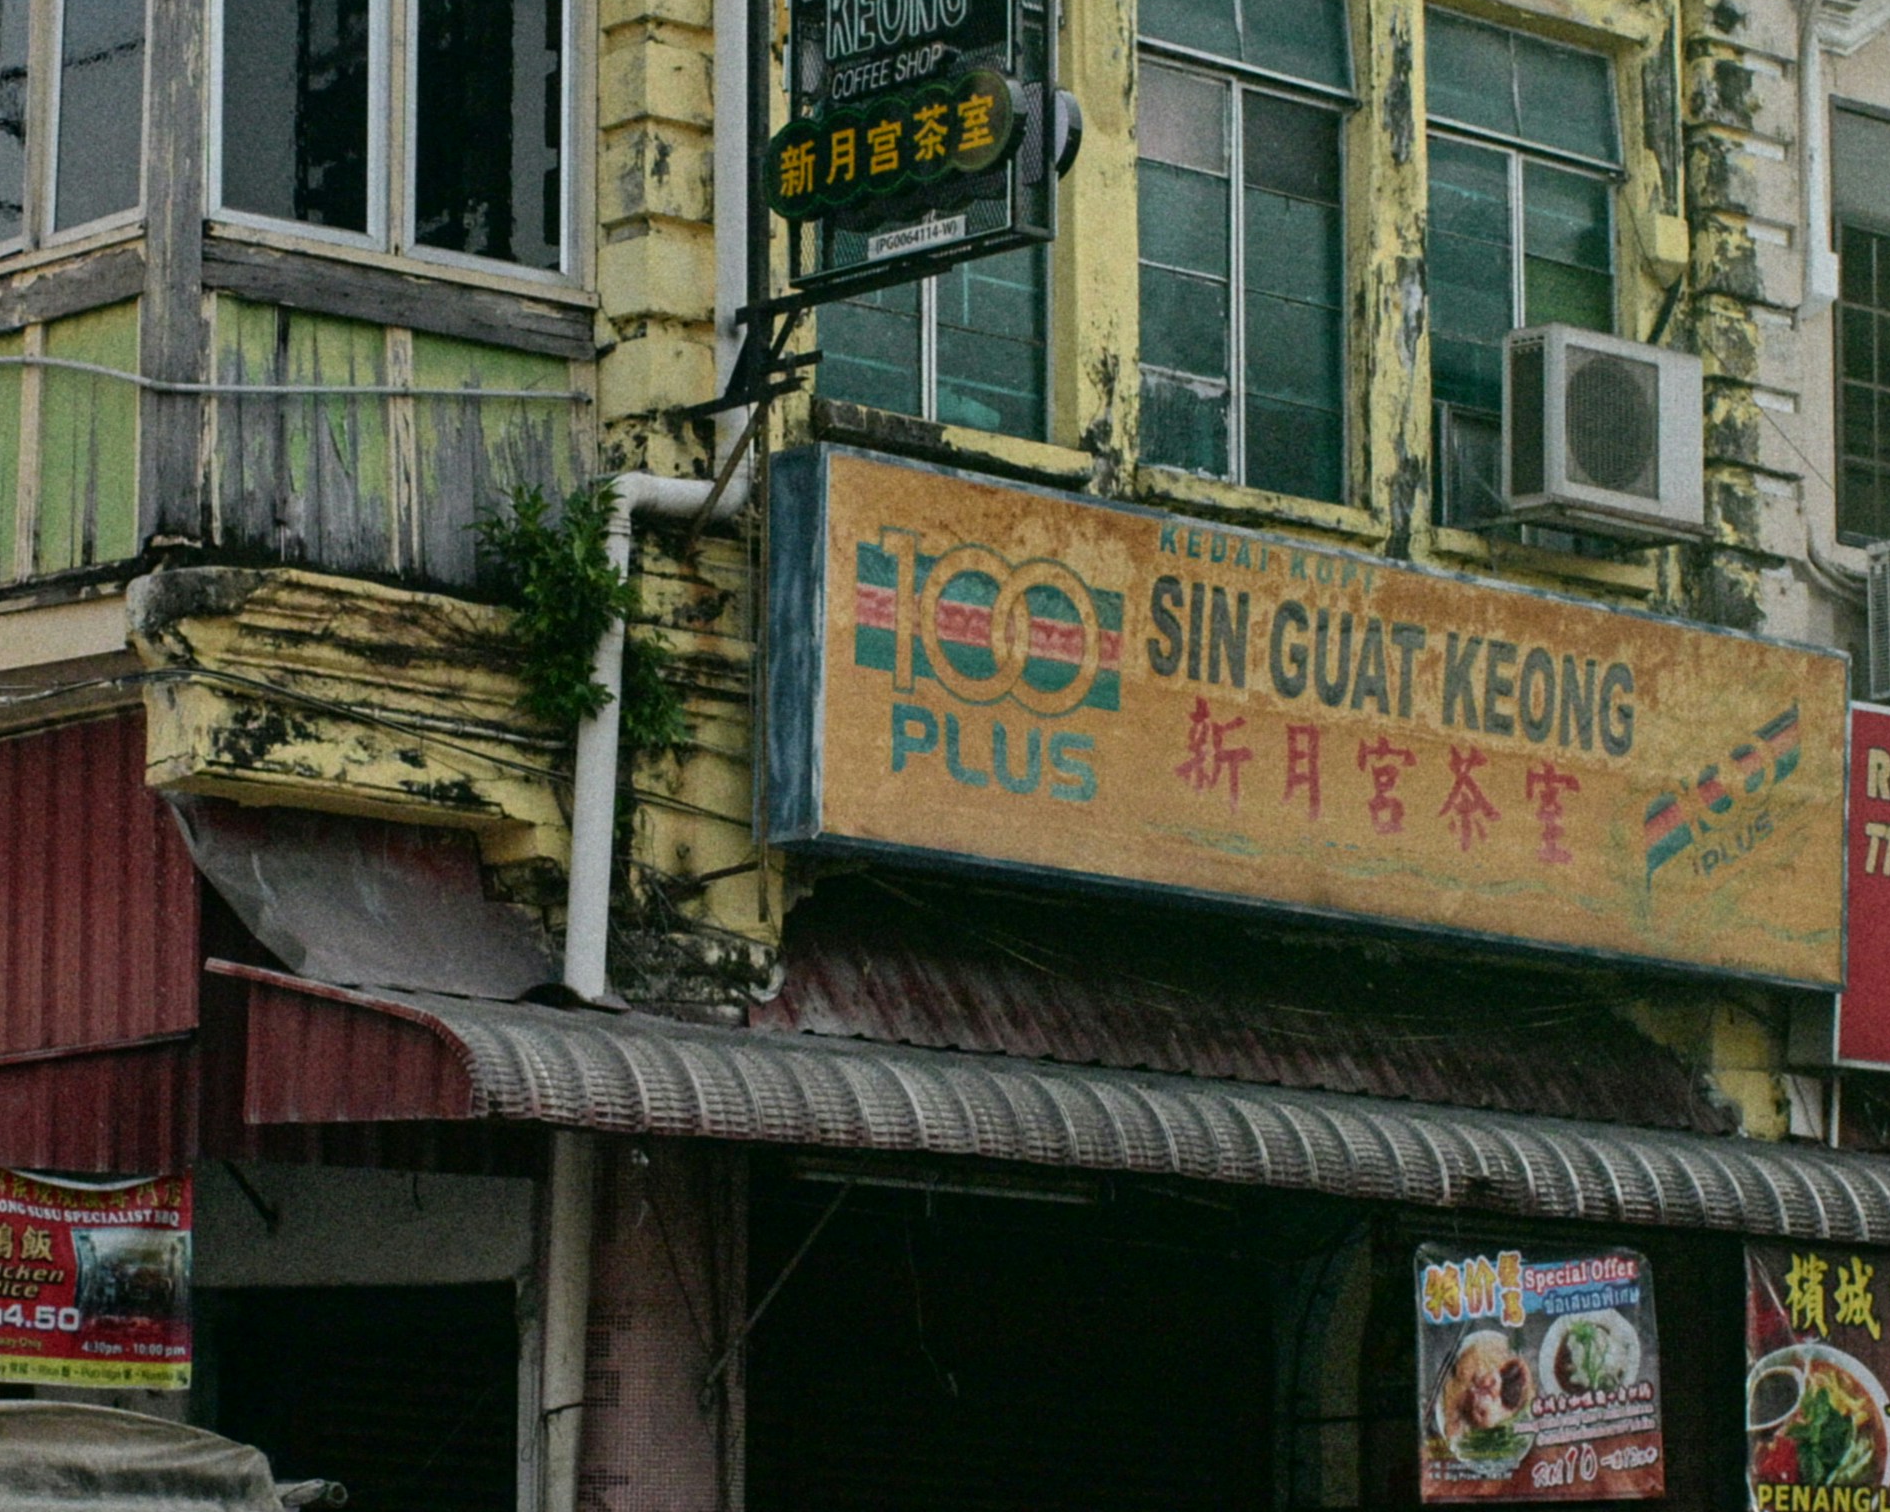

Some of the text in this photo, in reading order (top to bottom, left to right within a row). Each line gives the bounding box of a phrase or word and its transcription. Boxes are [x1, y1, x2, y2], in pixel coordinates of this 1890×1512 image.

[832, 45, 942, 99] COFFEE SHOP
[1161, 522, 1268, 572] KEDAI
[879, 525, 1100, 719] 100
[1147, 575, 1635, 758] SIN GUAT KEONG
[891, 702, 1098, 802] PLUS
[28, 1205, 61, 1222] SUSU
[64, 1209, 154, 1225] SPECIALIST
[1524, 1256, 1636, 1294] Special Offer
[133, 1343, 163, 1356] 10:00
[165, 1346, 186, 1358] pm
